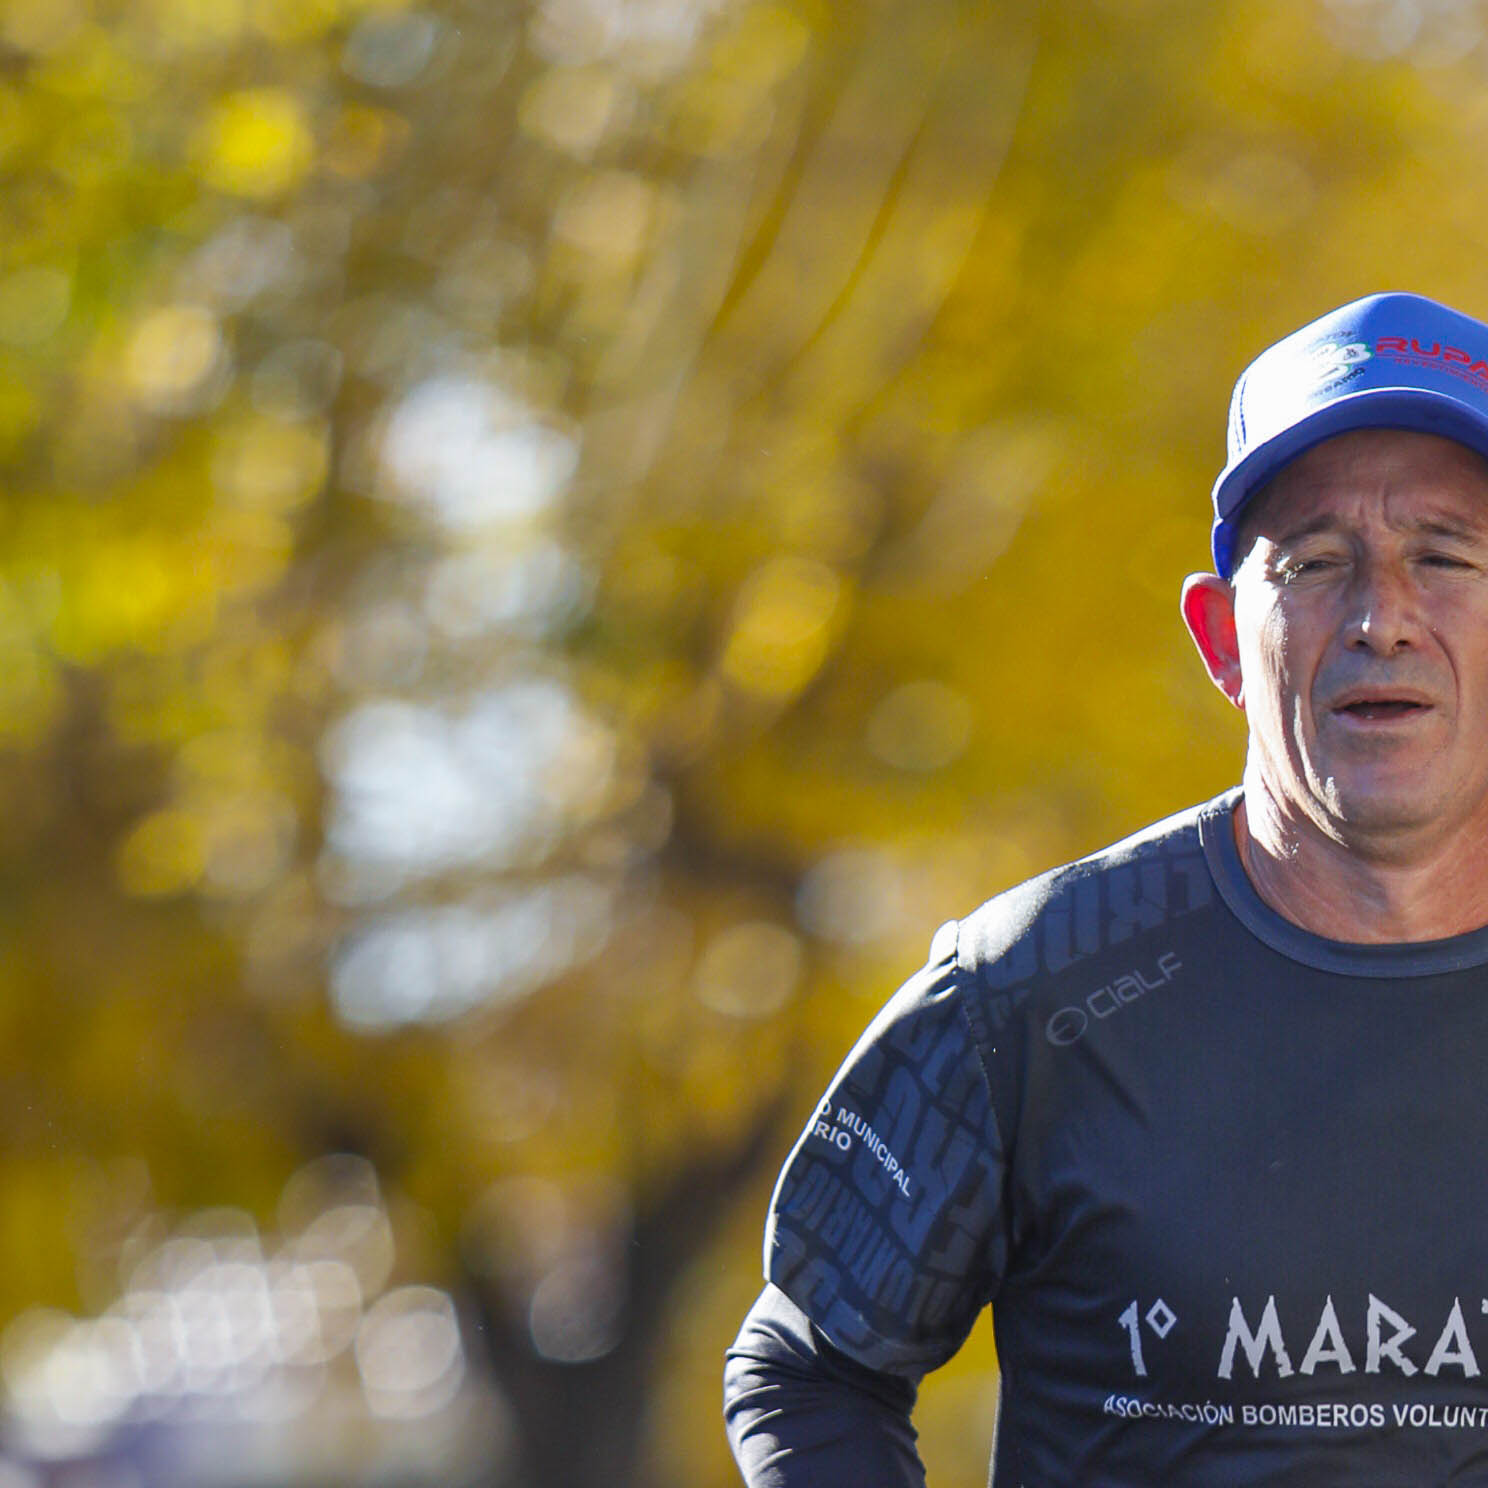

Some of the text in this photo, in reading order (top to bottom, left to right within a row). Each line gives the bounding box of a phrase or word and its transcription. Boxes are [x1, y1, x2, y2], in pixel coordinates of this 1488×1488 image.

[811, 1120, 852, 1151] RIO
[837, 1107, 912, 1197] MUNICIPAL
[1103, 1394, 1234, 1426] ASOCIACIÓN
[1242, 1403, 1385, 1428] BOMBEROS
